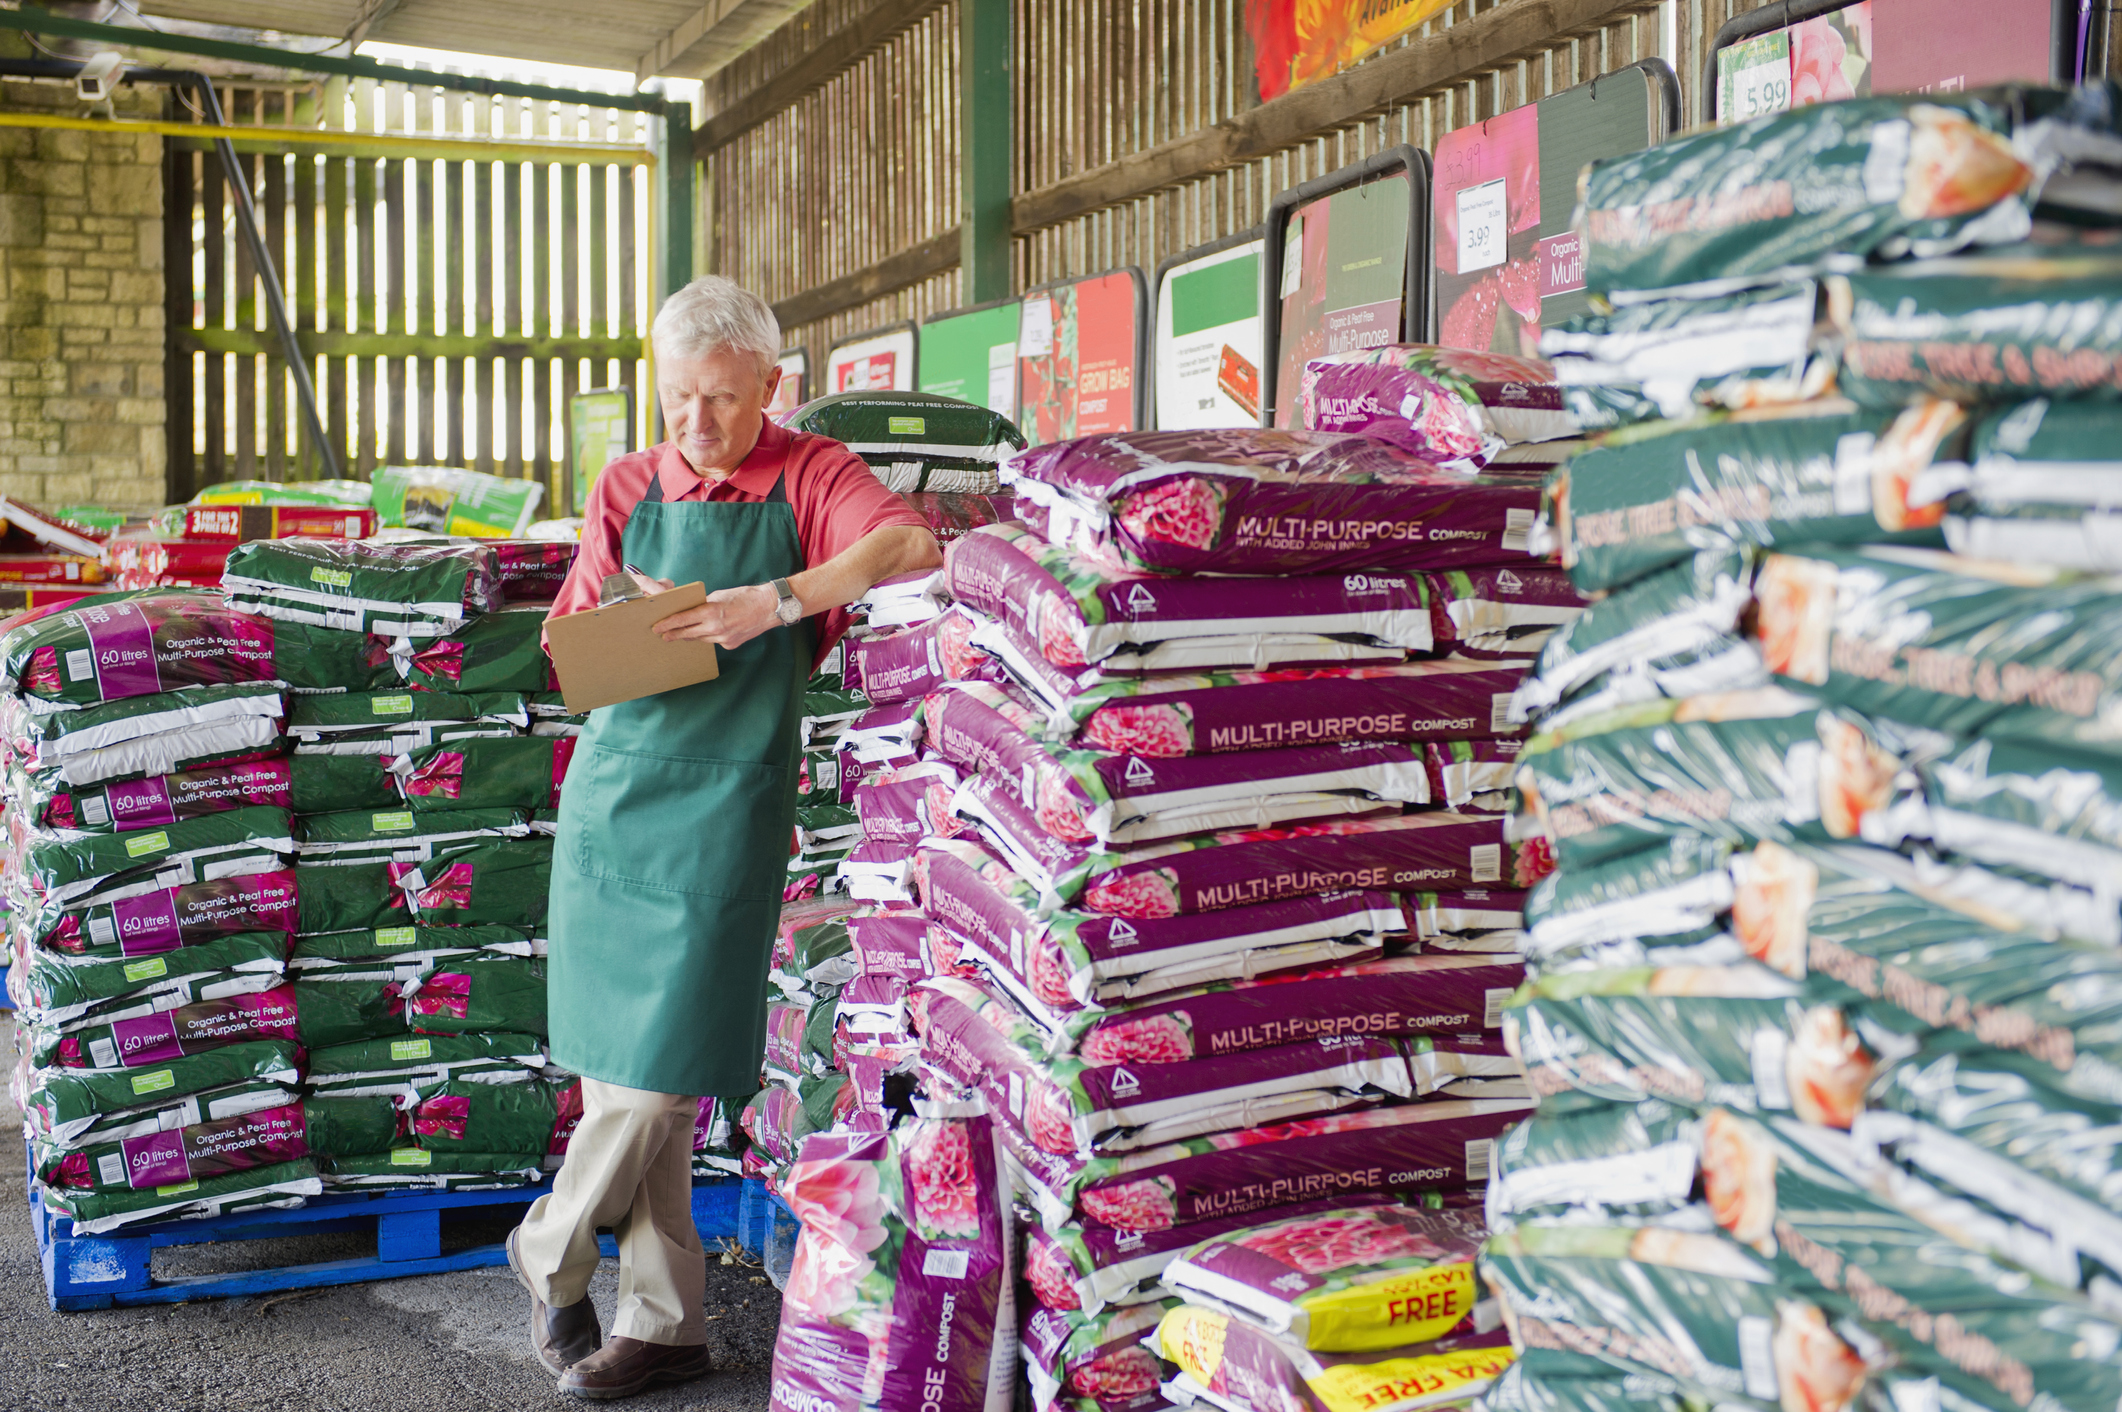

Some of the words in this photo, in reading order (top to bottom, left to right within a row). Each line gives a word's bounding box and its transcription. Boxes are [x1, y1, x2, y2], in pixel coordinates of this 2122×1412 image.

[1747, 79, 1786, 115] 5.99
[1444, 143, 1480, 191] £3.99
[1468, 225, 1490, 248] 3.99
[1551, 239, 1578, 258] Organic
[1330, 315, 1346, 330] Organic
[1347, 315, 1351, 325] &
[1352, 312, 1363, 325] Peat
[1363, 311, 1374, 322] Free
[1328, 329, 1389, 354] Multi-Purpose
[1080, 370, 1108, 394] GROW
[1109, 366, 1130, 390] BAG
[1079, 398, 1108, 415] COMPOST
[192, 510, 200, 533] 3
[201, 512, 215, 522] FOR
[216, 511, 230, 522] THE
[230, 513, 239, 535] 2
[200, 522, 220, 532] PRICE
[221, 522, 230, 532] OF
[940, 528, 948, 536] &
[1236, 516, 1423, 541] MULTI-PURPOSE
[1429, 528, 1489, 541] COMPOST
[1236, 537, 1262, 547] WITH
[1264, 538, 1304, 550] ADDED
[1305, 540, 1337, 551] JOHN
[1339, 541, 1370, 551] INNES
[1344, 574, 1368, 591] 60
[1369, 576, 1407, 590] litres
[167, 637, 205, 649] Organic
[207, 637, 215, 645] &
[217, 637, 239, 647] Peat
[241, 638, 261, 648] Free
[101, 650, 119, 664] 60
[121, 650, 148, 661] litres
[157, 648, 224, 662] Multi-Purpose
[849, 651, 858, 662] 6
[868, 665, 912, 690] MULTI-PURPOSE
[911, 664, 928, 681] COMPOST
[1210, 714, 1406, 747] MULTI-PURPOSE
[1412, 718, 1477, 731] COMPOST
[180, 778, 219, 791] Organic
[221, 777, 229, 785] &
[231, 773, 253, 784] Peat
[256, 771, 277, 780] Free
[845, 765, 861, 777] 60
[116, 796, 134, 810] 60
[135, 793, 162, 806] litres
[172, 787, 240, 805] Multi-Purpose
[242, 781, 290, 798] Compost
[1197, 867, 1388, 908] MULTI-PURPOSE
[1394, 869, 1457, 883] COMPOST
[187, 898, 227, 911] Organic
[229, 895, 237, 903] &
[239, 891, 261, 901] Peat
[263, 888, 285, 897] Free
[123, 917, 141, 931] 60
[143, 913, 170, 928] litres
[180, 905, 247, 926] Multi-Purpose
[250, 897, 296, 914] Compost
[180, 1023, 247, 1041] Multi-Purpose
[250, 1016, 296, 1031] Compost
[187, 1015, 227, 1029] Organic
[229, 1012, 236, 1020] &
[238, 1009, 260, 1018] Peat
[263, 1006, 284, 1015] Free
[124, 1035, 141, 1050] 60
[143, 1032, 169, 1046] litres
[1211, 1012, 1400, 1050] MULTI-PURPOSE
[1407, 1014, 1470, 1027] COMPOST
[196, 1130, 235, 1145] Organic
[238, 1127, 246, 1136] &
[247, 1121, 269, 1133] Peat
[272, 1119, 292, 1128] Free
[189, 1139, 256, 1160] Multi-Purpose
[258, 1129, 303, 1147] Compost
[132, 1152, 150, 1167] 60
[152, 1148, 178, 1162] litres
[1195, 1168, 1382, 1214] MULTI-PURPOSE
[1388, 1167, 1451, 1184] COMPOST
[1388, 1290, 1457, 1326] FREE
[936, 1292, 956, 1363] COMPOST
[1352, 1375, 1444, 1410] FREE
